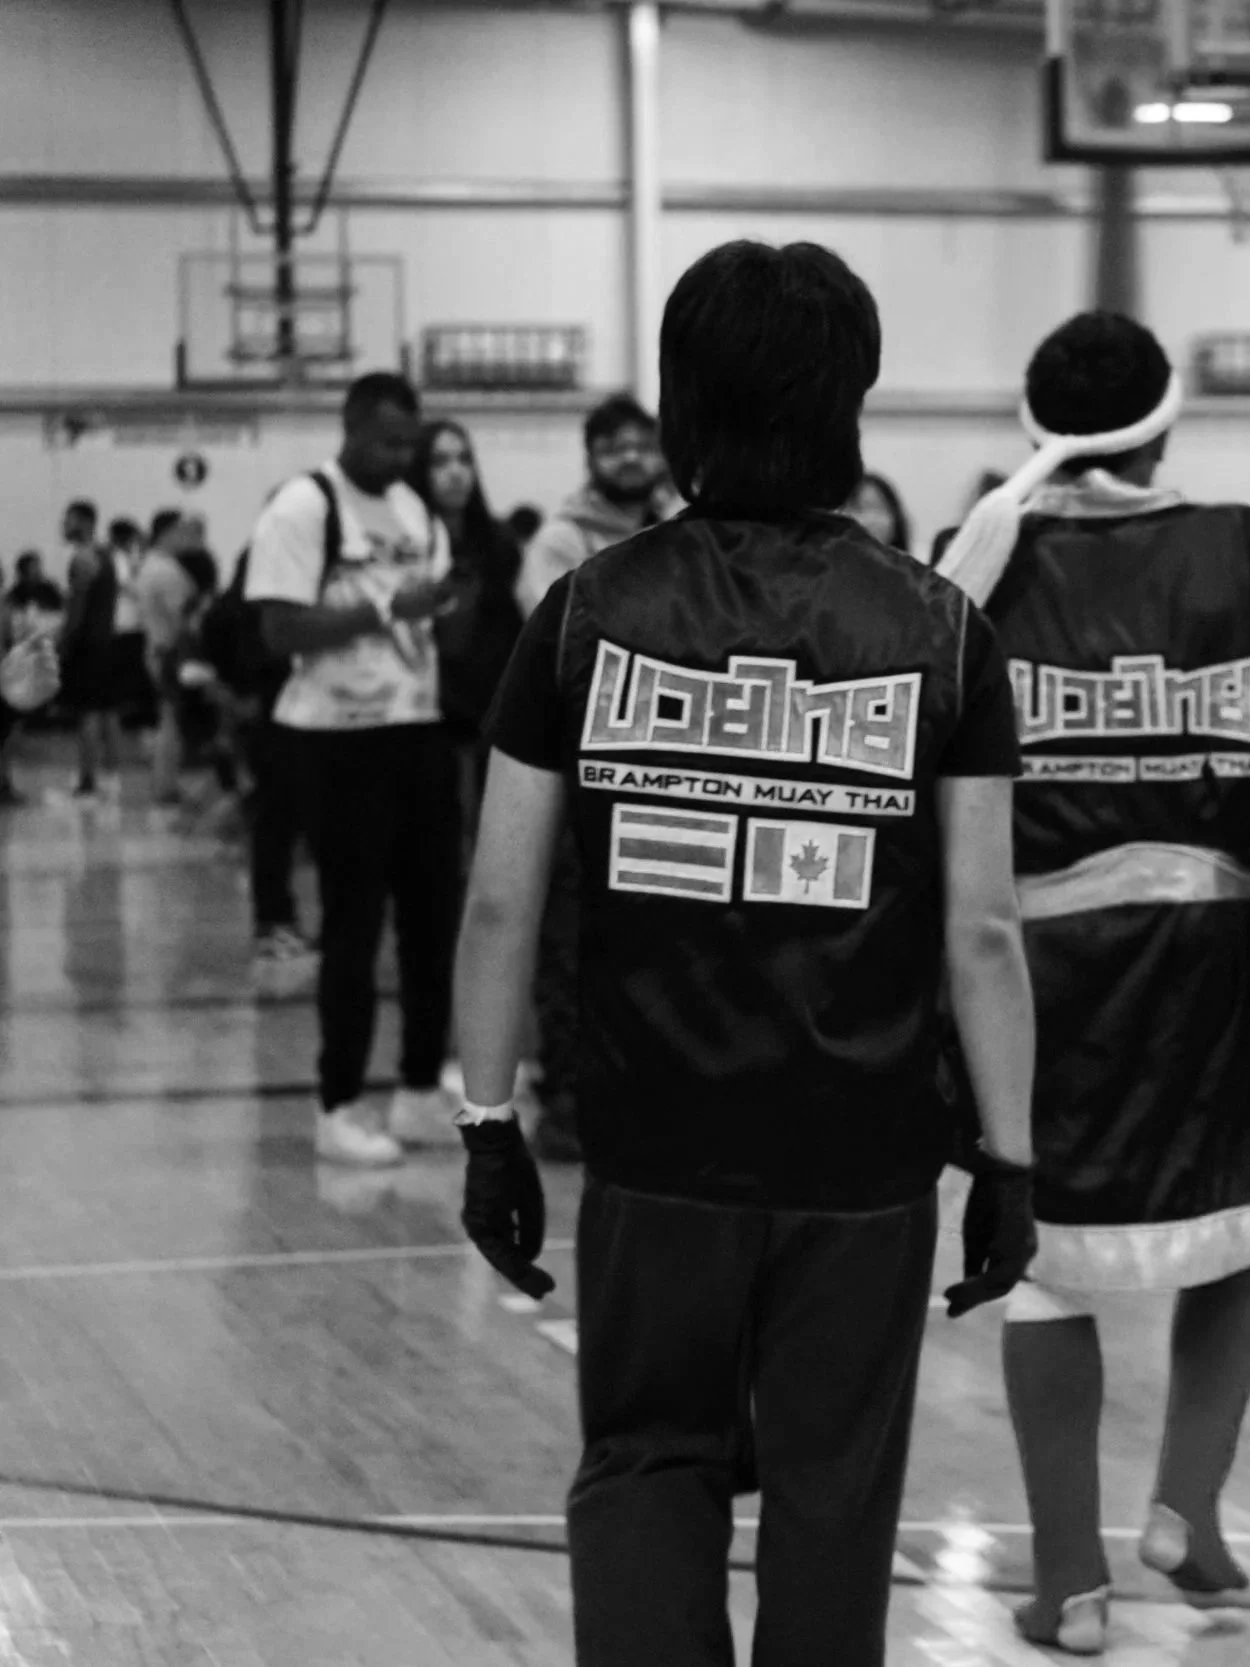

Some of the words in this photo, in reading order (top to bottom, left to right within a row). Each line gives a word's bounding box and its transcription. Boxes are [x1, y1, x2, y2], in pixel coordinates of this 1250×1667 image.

[1021, 761, 1131, 777] RAMPTON
[1143, 759, 1199, 776] MUAY
[584, 766, 742, 797] BRAMPTON
[754, 784, 834, 806] MUAY
[845, 791, 909, 811] THAI
